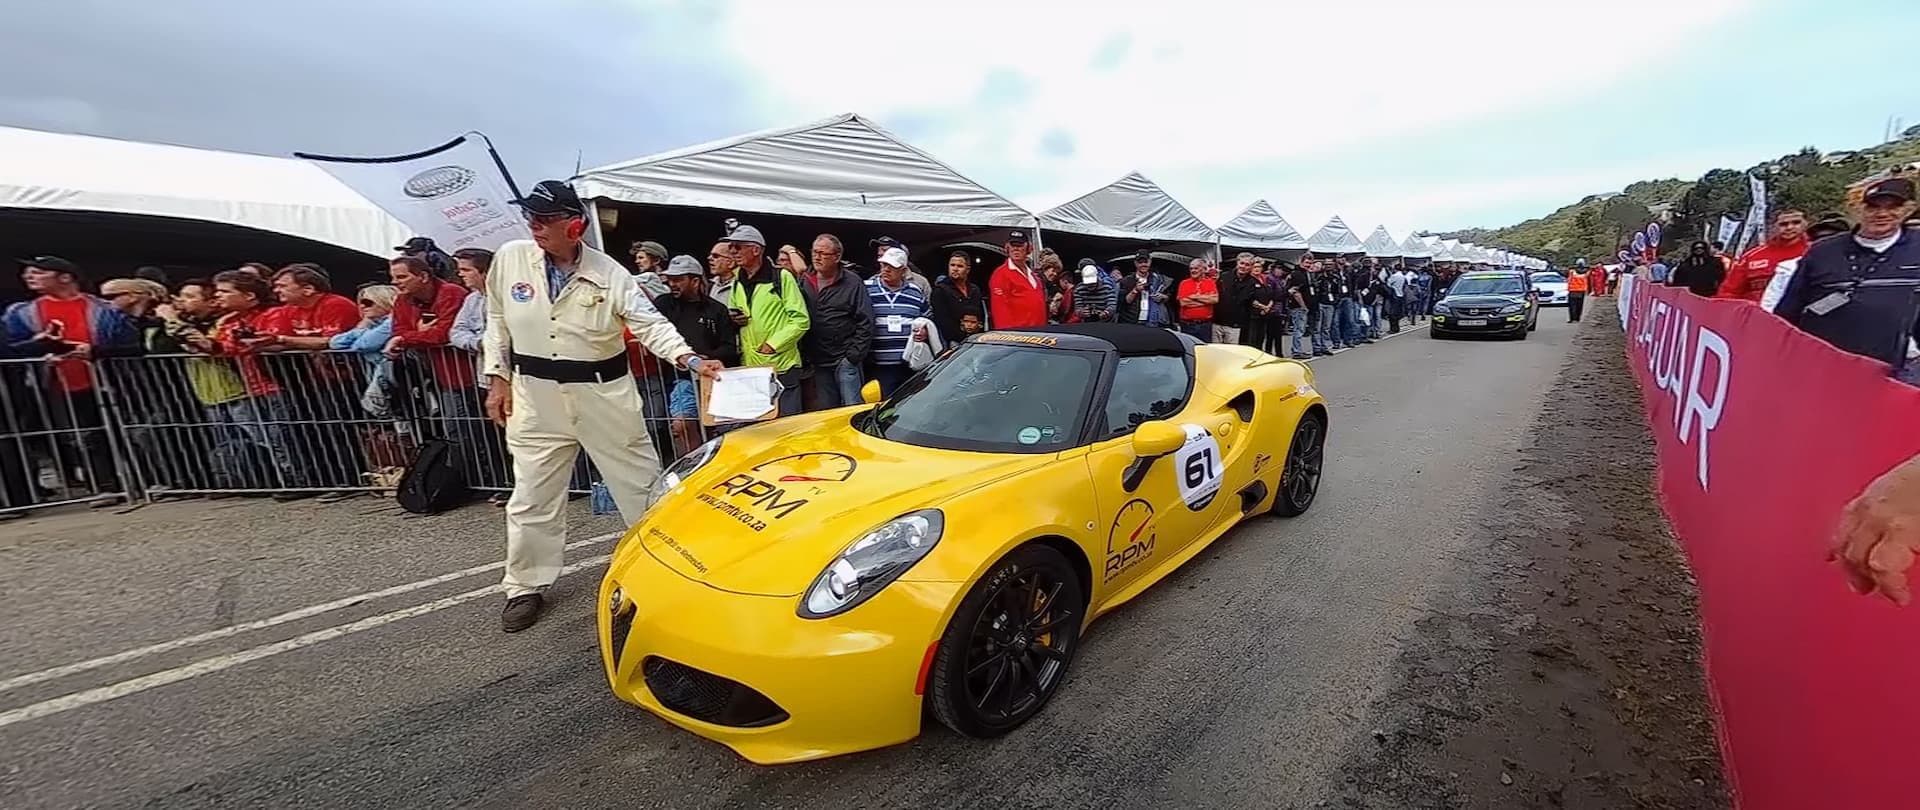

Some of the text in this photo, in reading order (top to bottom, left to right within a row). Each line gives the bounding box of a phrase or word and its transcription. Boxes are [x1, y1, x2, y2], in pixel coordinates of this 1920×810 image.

[1635, 295, 1730, 494] JAGUAR
[1185, 447, 1215, 489] 61
[711, 474, 809, 520] RPM
[1104, 533, 1156, 577] RPM
